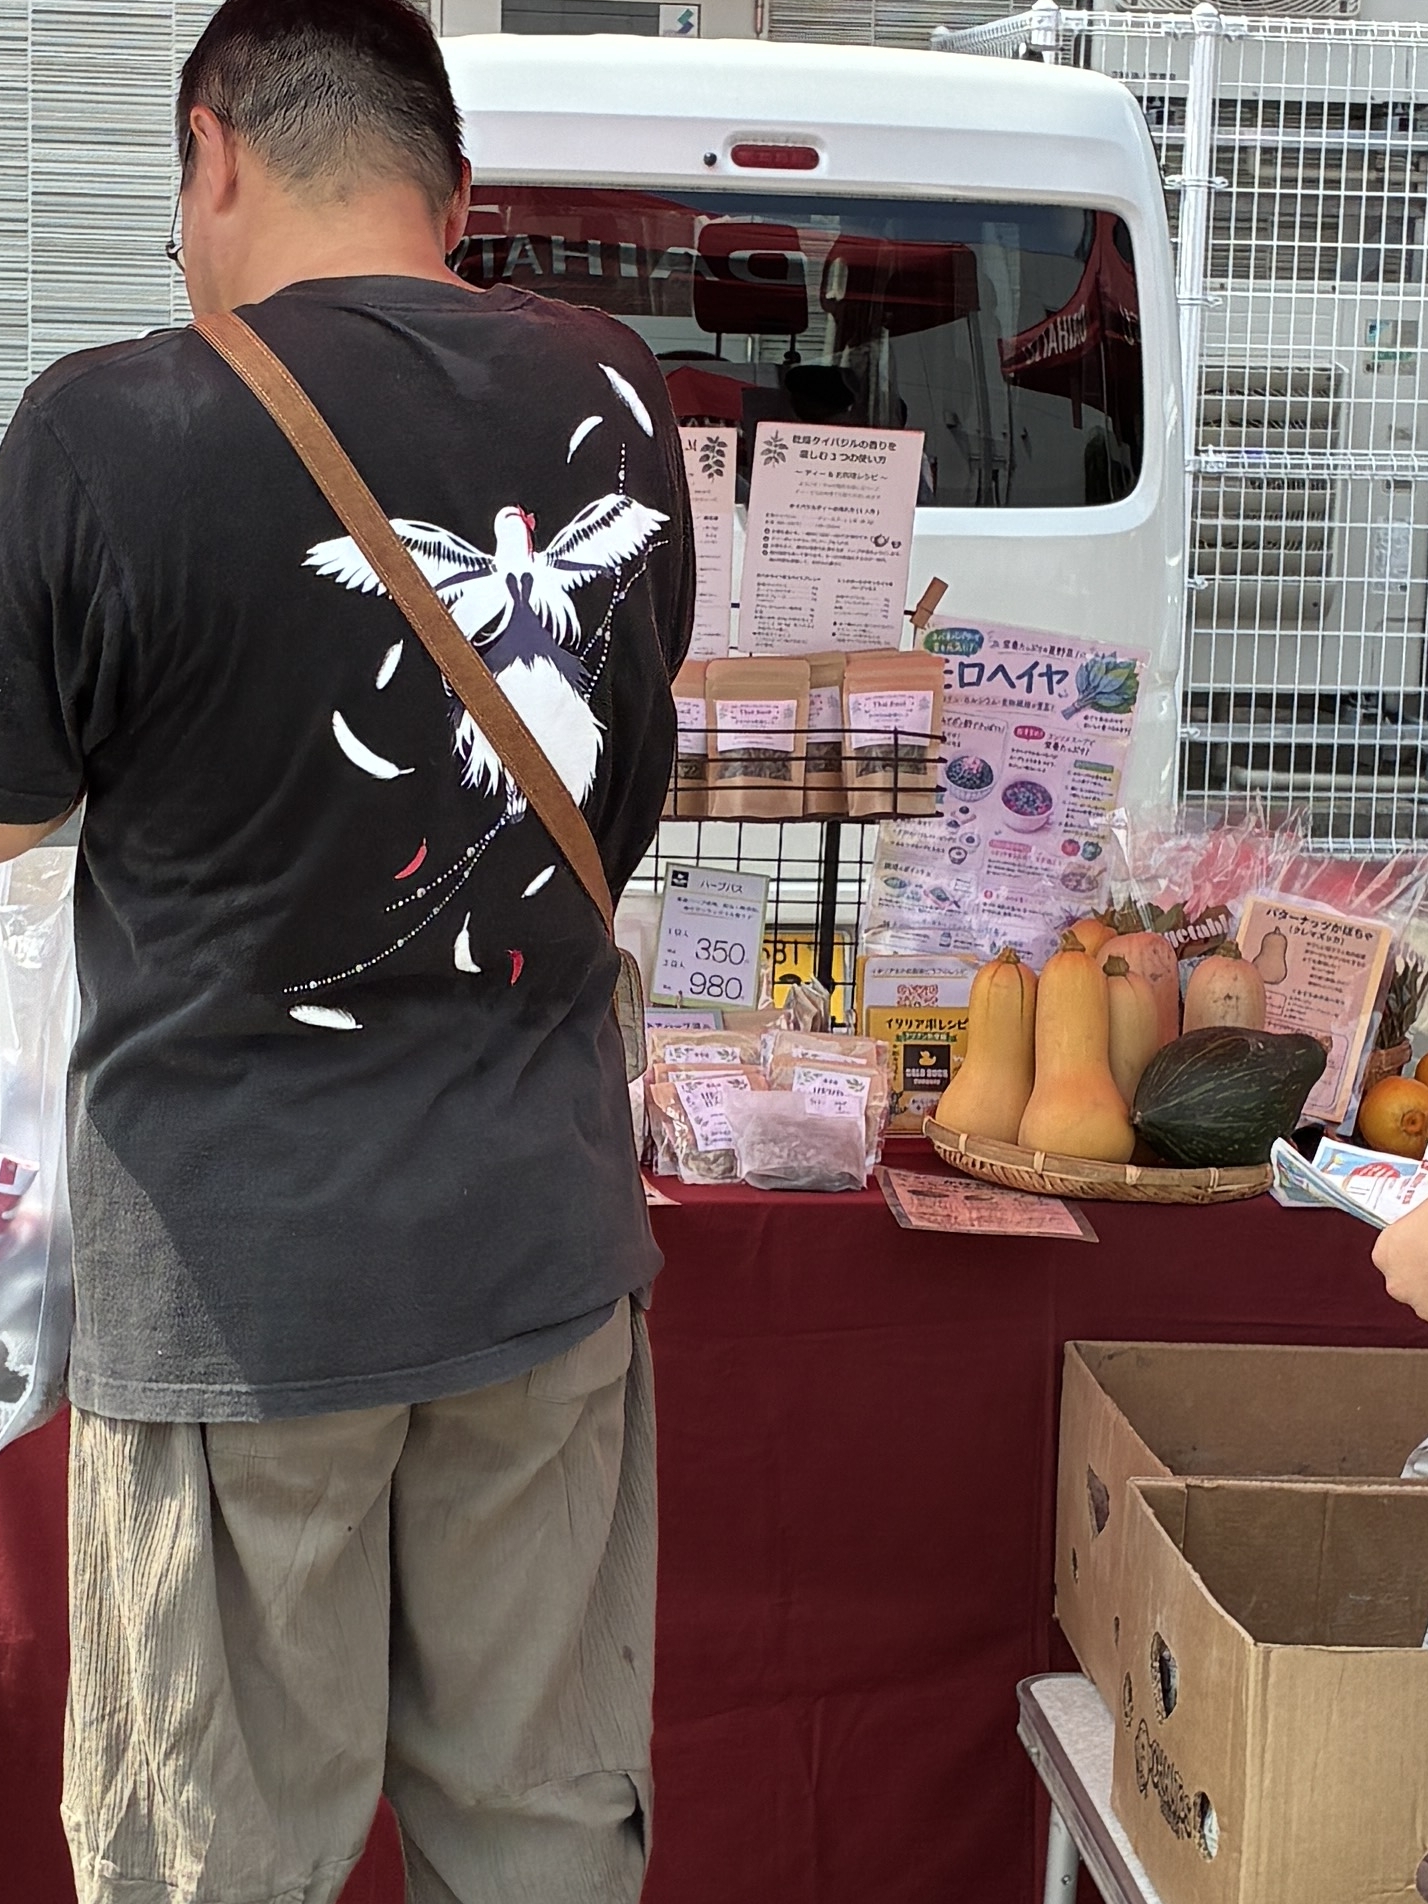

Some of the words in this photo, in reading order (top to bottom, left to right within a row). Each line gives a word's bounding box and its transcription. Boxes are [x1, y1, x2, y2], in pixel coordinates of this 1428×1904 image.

[1266, 907, 1374, 941] バターナッツかぼちゃ
